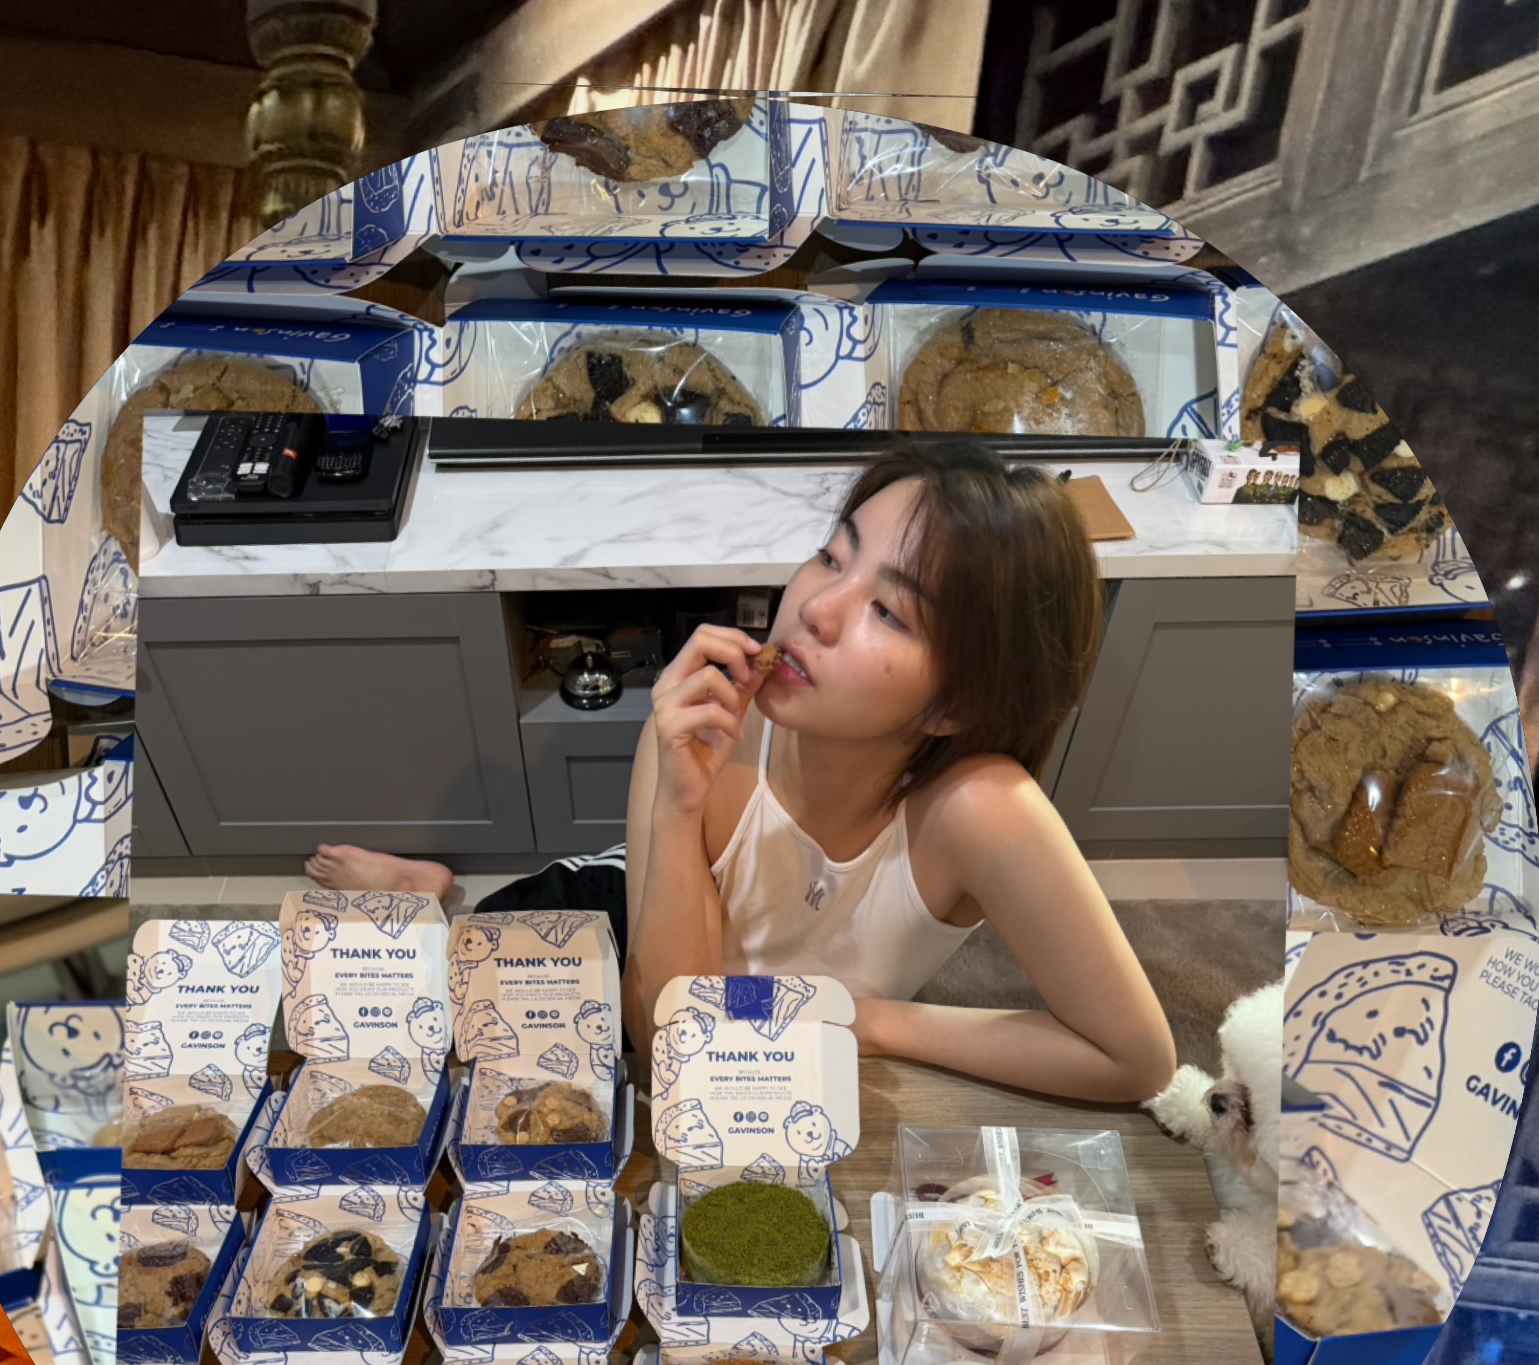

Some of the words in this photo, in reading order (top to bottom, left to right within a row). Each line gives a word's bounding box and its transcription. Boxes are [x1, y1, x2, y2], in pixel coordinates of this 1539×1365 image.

[329, 948, 383, 960] THANK
[384, 948, 417, 960] YOU
[1504, 946, 1524, 966] WE
[493, 957, 548, 968] THANK
[550, 956, 583, 968] YOU
[1486, 955, 1517, 978] HOW
[177, 984, 227, 994] THANK
[229, 984, 260, 994] YOU
[1479, 968, 1520, 1000] PLEASE
[353, 1021, 398, 1029] GAVINSON
[180, 1042, 226, 1050] GAVINSON
[706, 1051, 759, 1063] THANK
[762, 1051, 795, 1063] YOU
[727, 1127, 775, 1135] GAVINSON
[1016, 1270, 1027, 1304] WISHES
[1021, 1307, 1031, 1329] BEST
